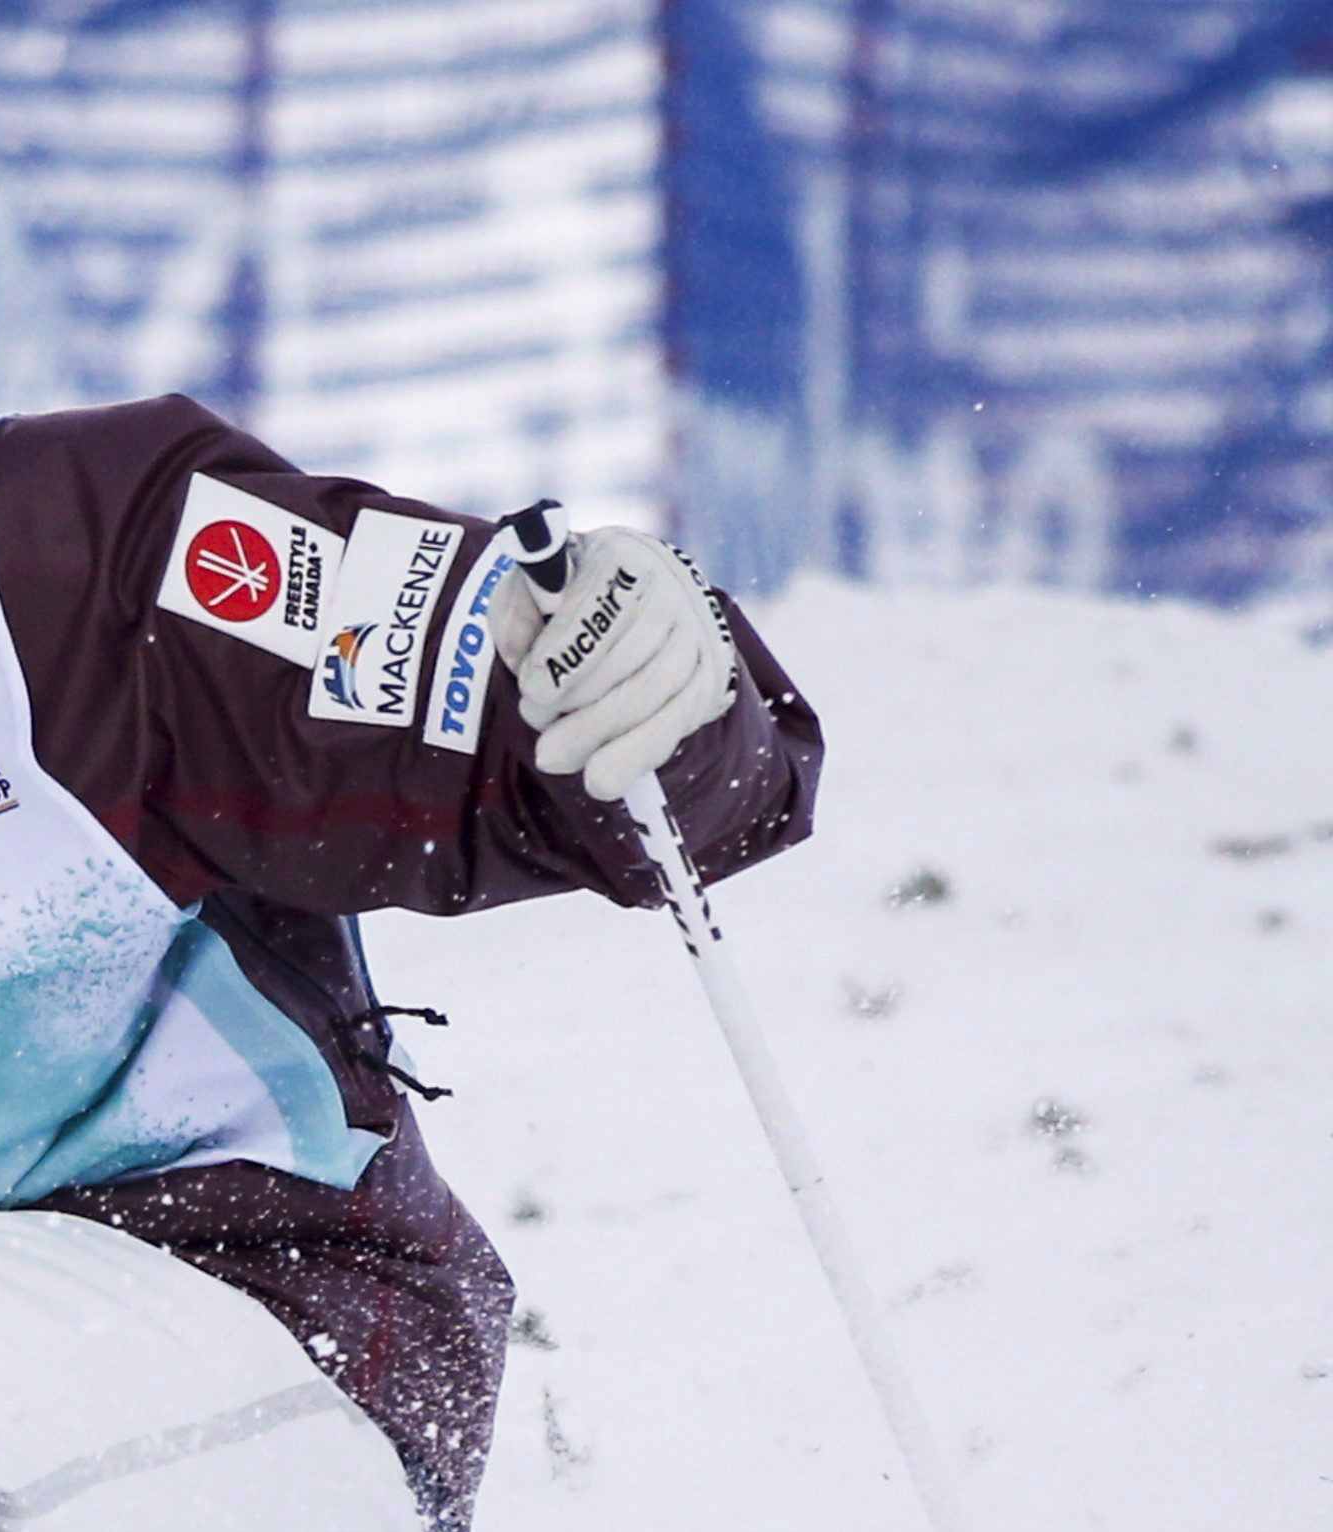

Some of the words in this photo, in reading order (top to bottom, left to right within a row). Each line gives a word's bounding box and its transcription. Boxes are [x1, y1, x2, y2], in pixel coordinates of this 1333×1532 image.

[284, 525, 306, 627] FREESTYLE
[302, 557, 323, 631] CANADA
[376, 529, 451, 714] MACKENZIE
[441, 623, 485, 735] TOYO
[546, 586, 622, 688] Auclair
